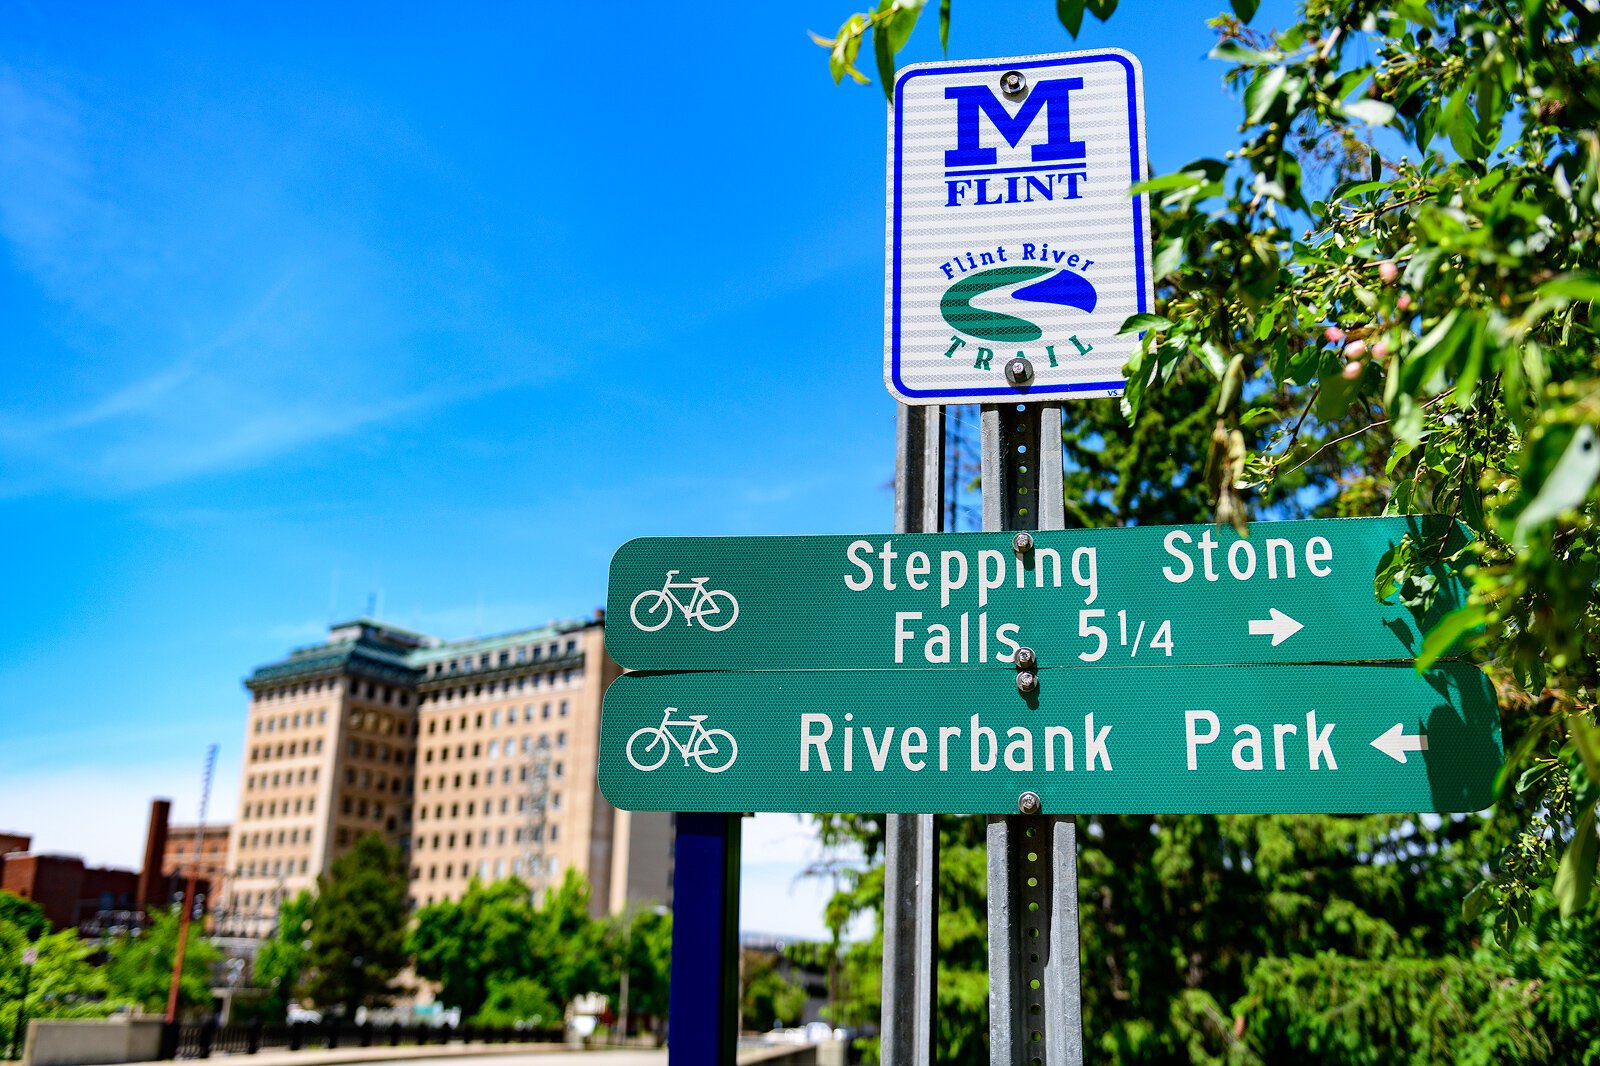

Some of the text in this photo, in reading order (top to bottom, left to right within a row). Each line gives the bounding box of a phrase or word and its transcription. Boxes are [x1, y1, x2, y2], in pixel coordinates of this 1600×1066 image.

[945, 77, 1086, 166] M
[945, 173, 1087, 207] FLINT
[940, 243, 1095, 280] Flint River
[844, 529, 1334, 607] Stepping Stone
[894, 611, 1021, 664] Falls
[800, 709, 1339, 772] Riverbank Park
